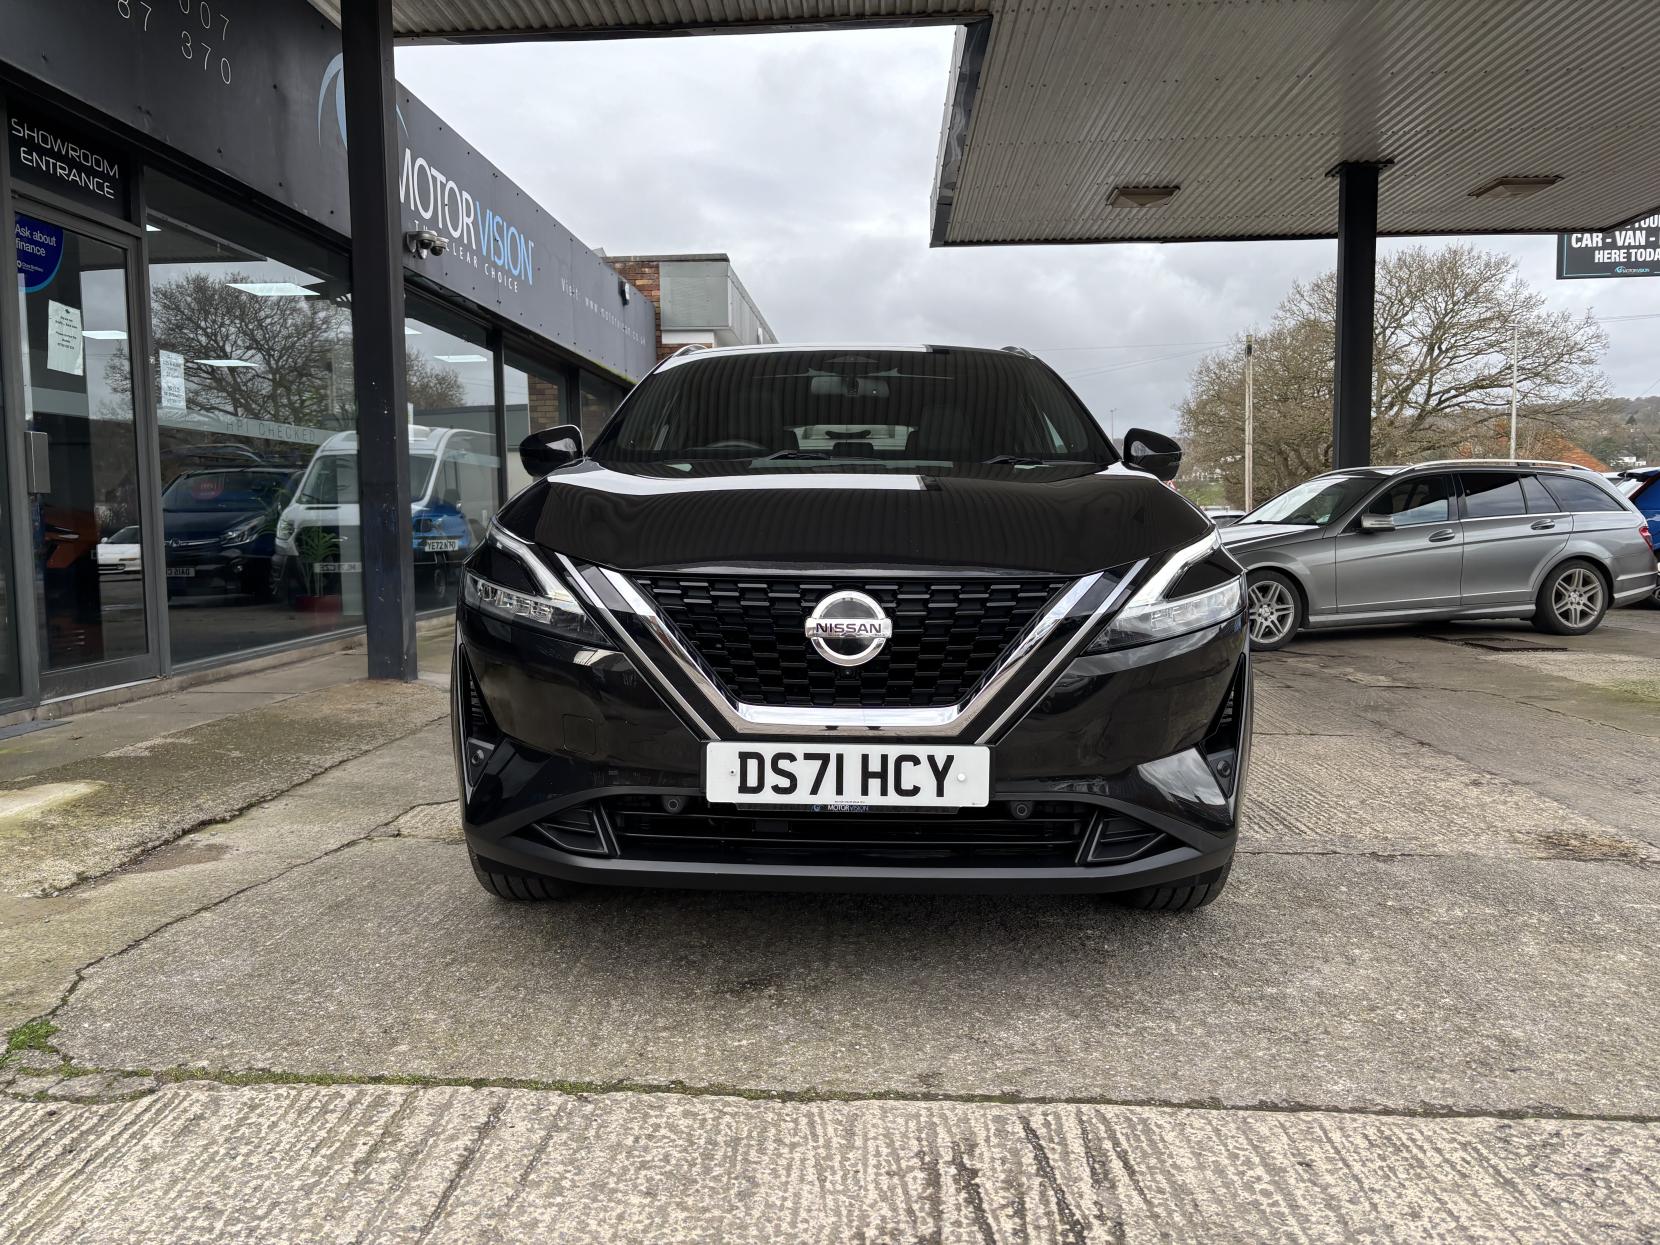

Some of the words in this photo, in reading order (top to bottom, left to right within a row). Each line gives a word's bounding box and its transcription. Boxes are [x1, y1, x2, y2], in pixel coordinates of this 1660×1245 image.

[11, 118, 119, 180] SHOWROOM
[20, 146, 115, 200] ENTRANCE
[15, 223, 31, 239] Ask
[32, 230, 57, 247] about
[1571, 233, 1603, 248] CAR
[1615, 230, 1646, 247] VAN
[15, 237, 46, 257] finance
[1594, 249, 1628, 263] HERE
[484, 263, 518, 293] CHOICE
[258, 422, 316, 442] CHECKED
[816, 622, 882, 634] NISSAN
[737, 751, 844, 796] DS71
[860, 752, 955, 798] HCY
